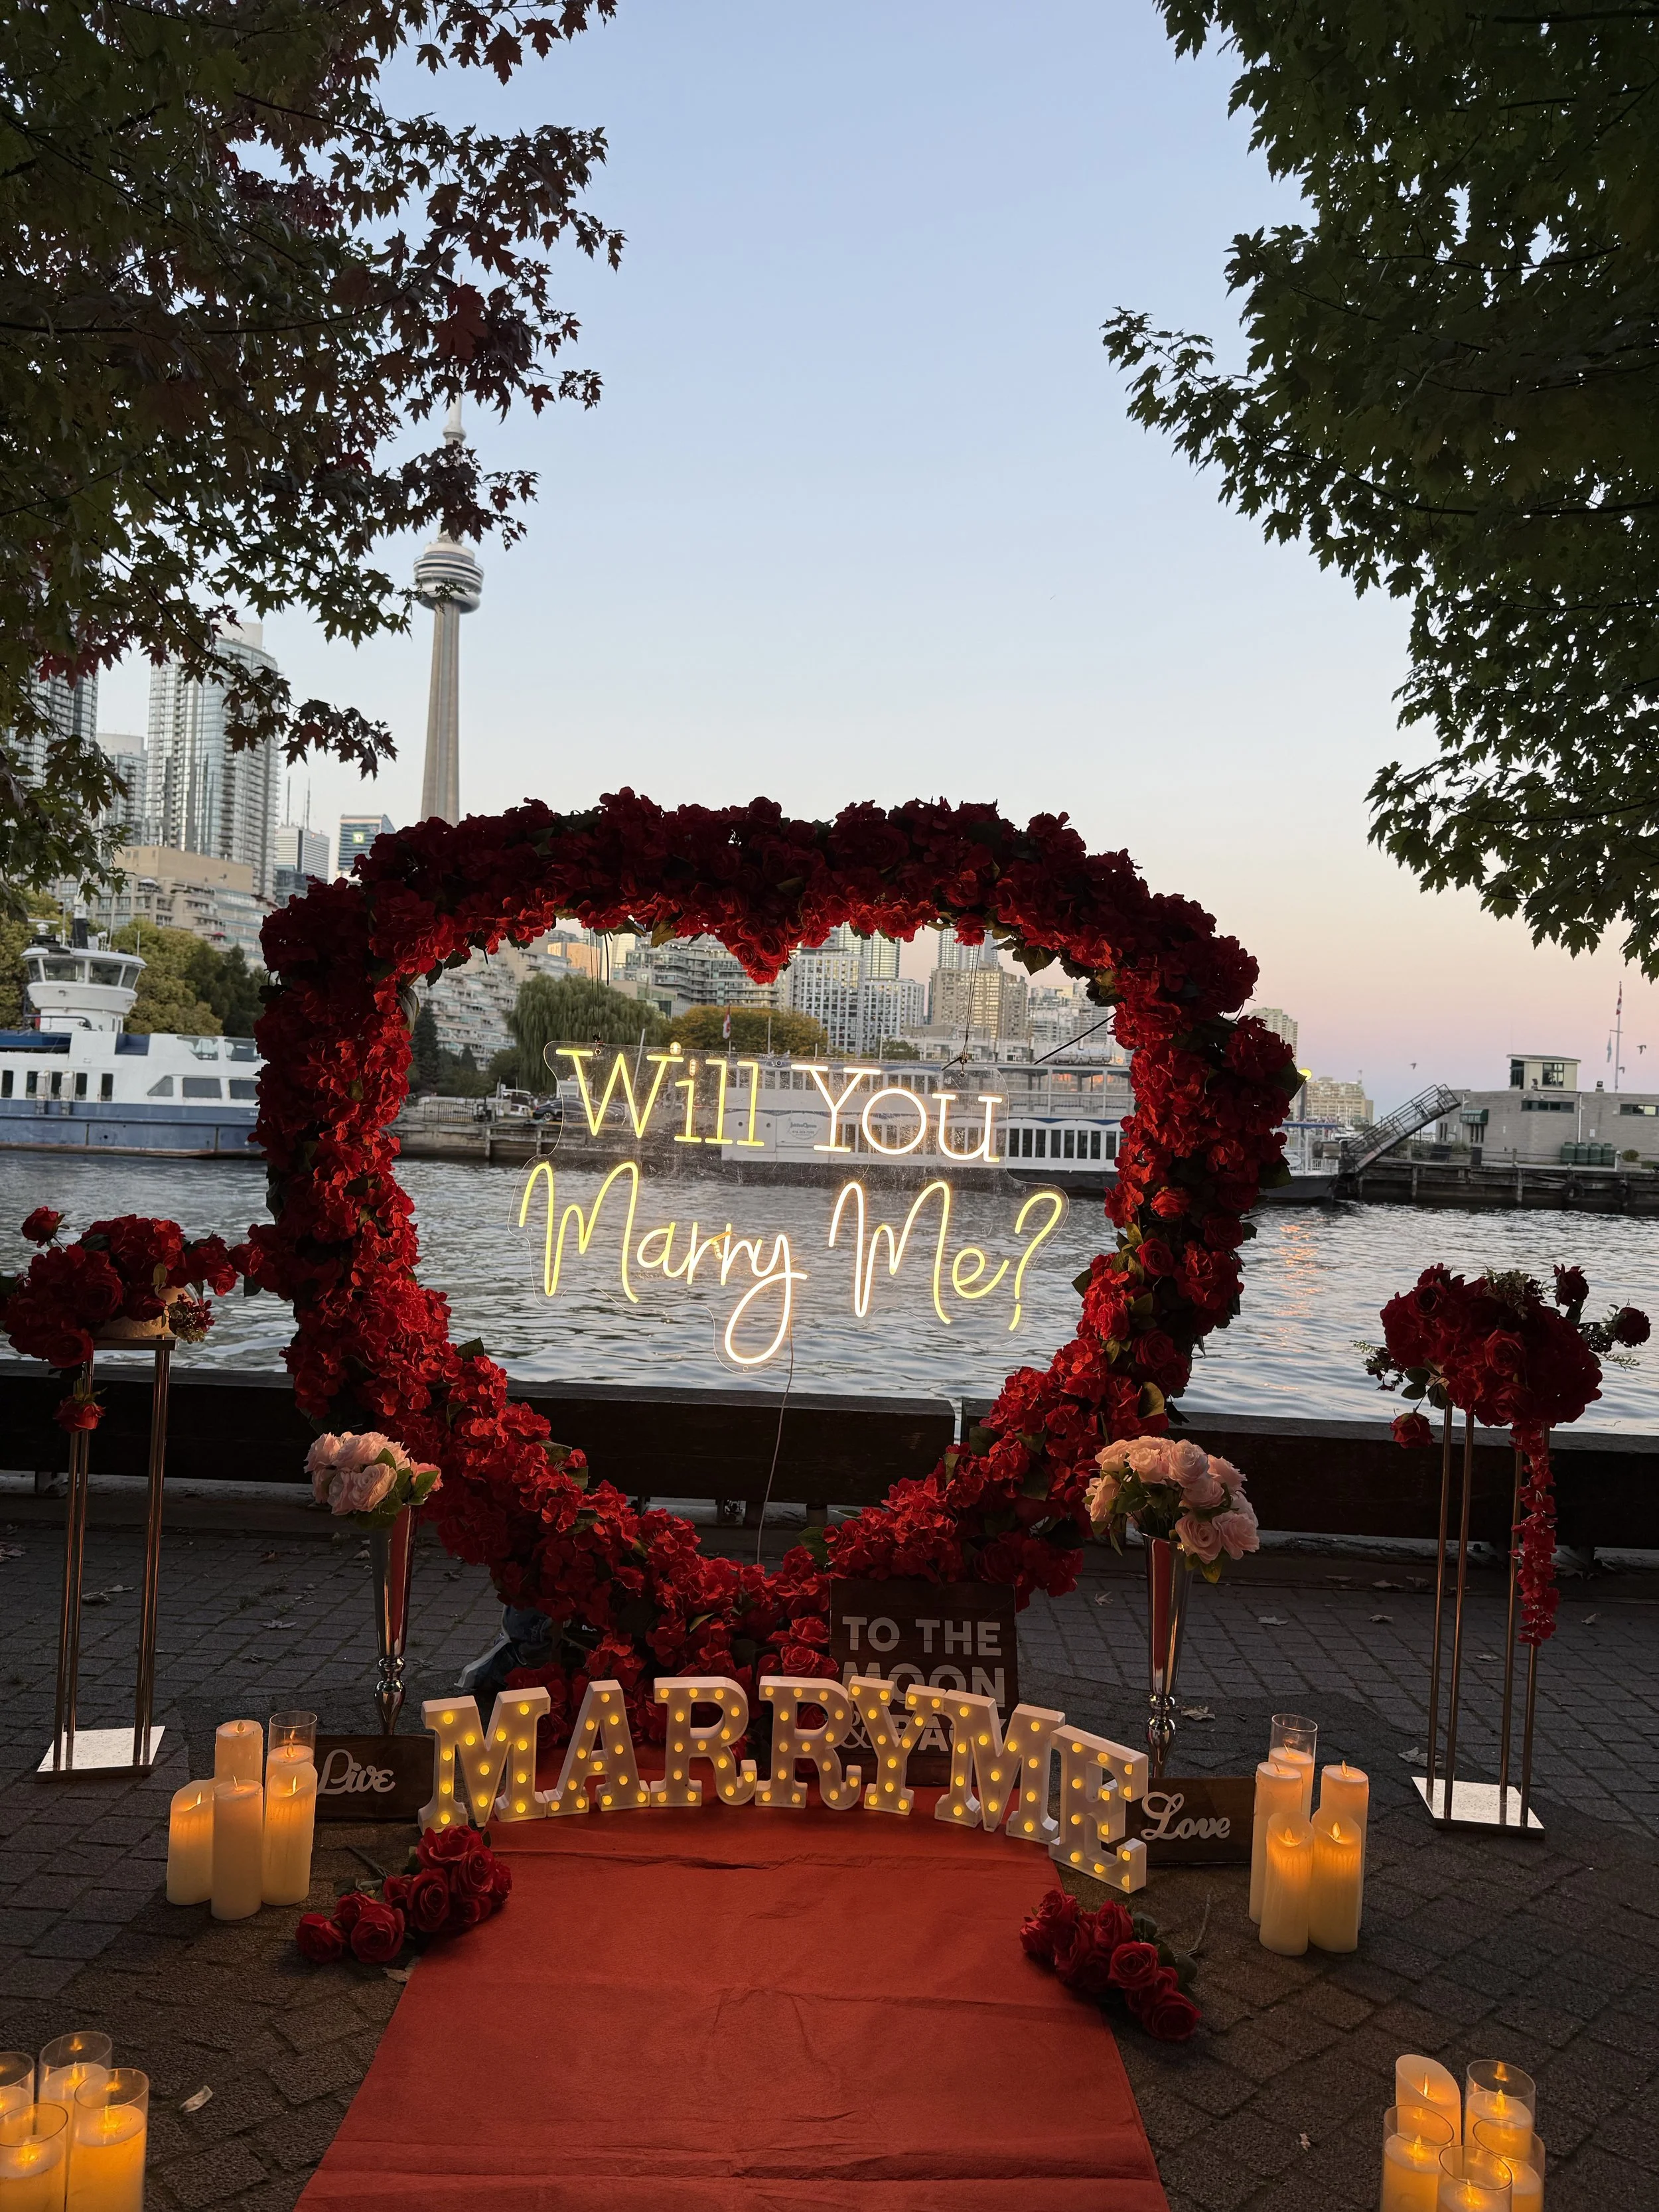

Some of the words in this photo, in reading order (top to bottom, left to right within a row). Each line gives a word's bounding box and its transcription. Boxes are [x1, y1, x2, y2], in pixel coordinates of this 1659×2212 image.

[556, 1049, 764, 1147] Will
[790, 1064, 1003, 1163] You
[519, 1161, 808, 1364] Marry
[829, 1181, 1062, 1331] Me?
[842, 1616, 900, 1652] TO
[915, 1619, 1002, 1656] THE
[317, 1749, 396, 1795] Live
[1140, 1791, 1231, 1841] Love
